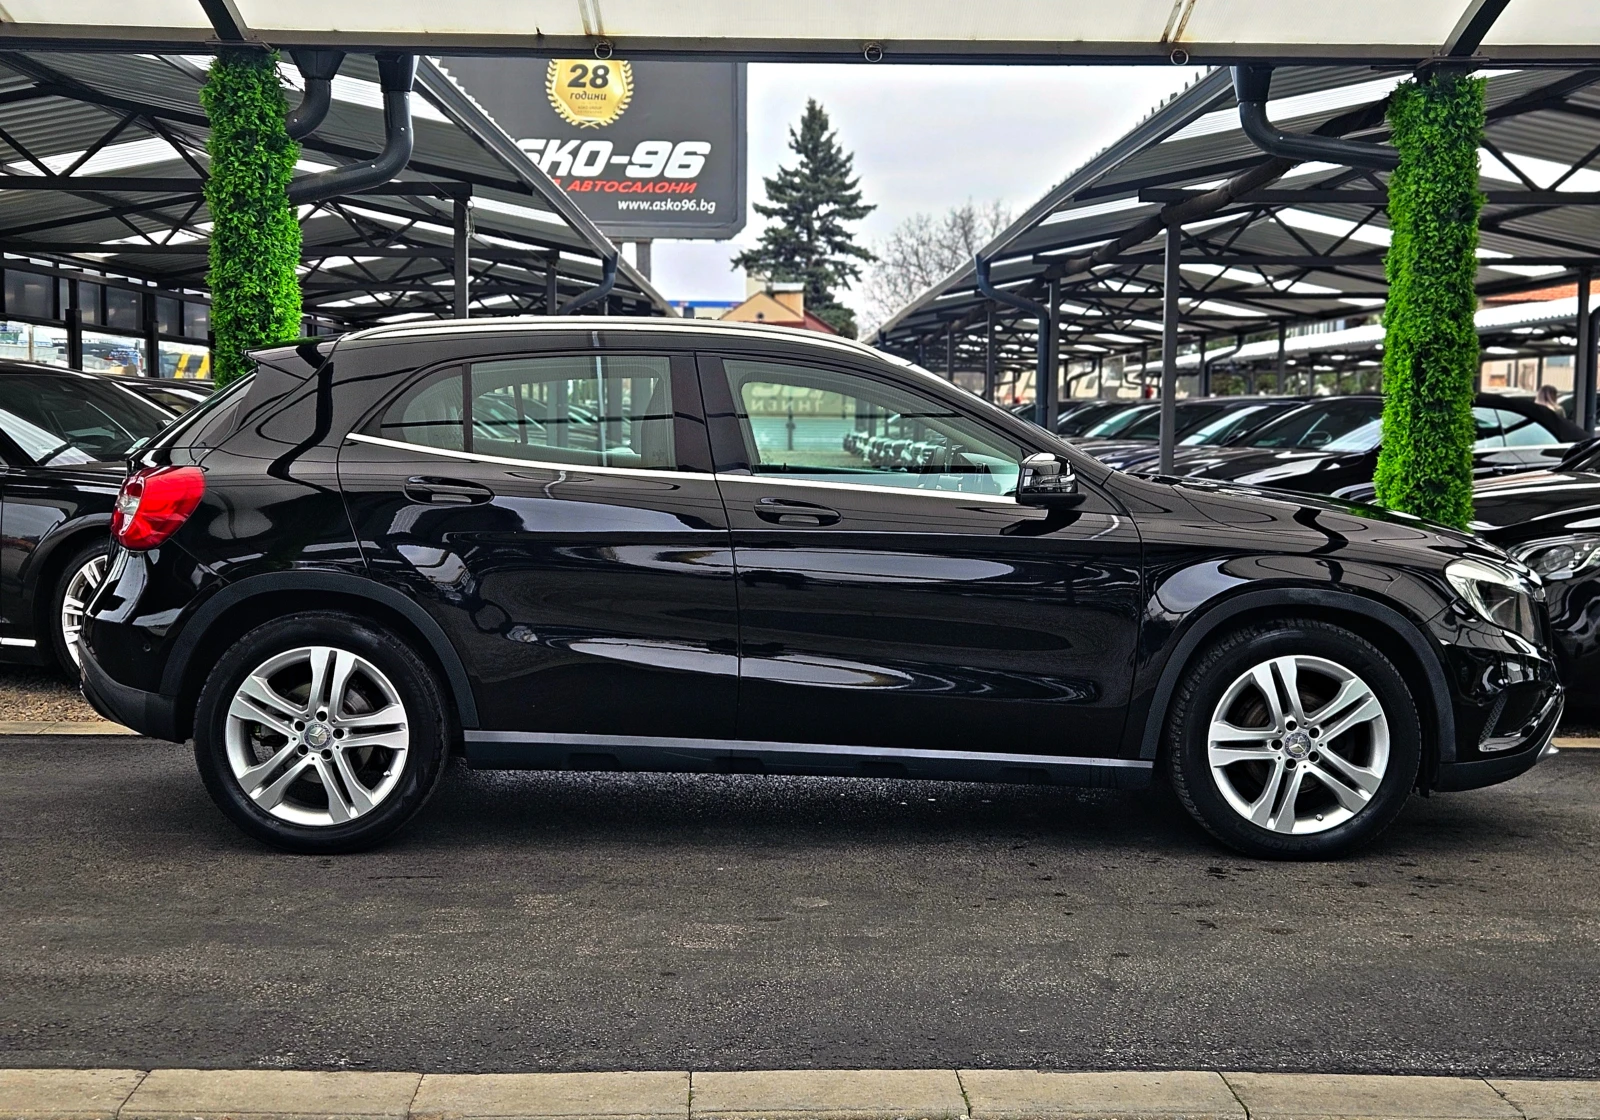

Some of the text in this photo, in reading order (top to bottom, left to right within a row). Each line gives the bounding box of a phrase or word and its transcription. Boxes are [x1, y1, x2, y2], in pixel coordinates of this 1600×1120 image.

[567, 63, 610, 89] 28
[570, 91, 607, 101] години
[514, 138, 712, 178] SKO-96
[566, 180, 697, 194] АВТОСАЛОНИ
[617, 198, 716, 214] www.asko96.bg
